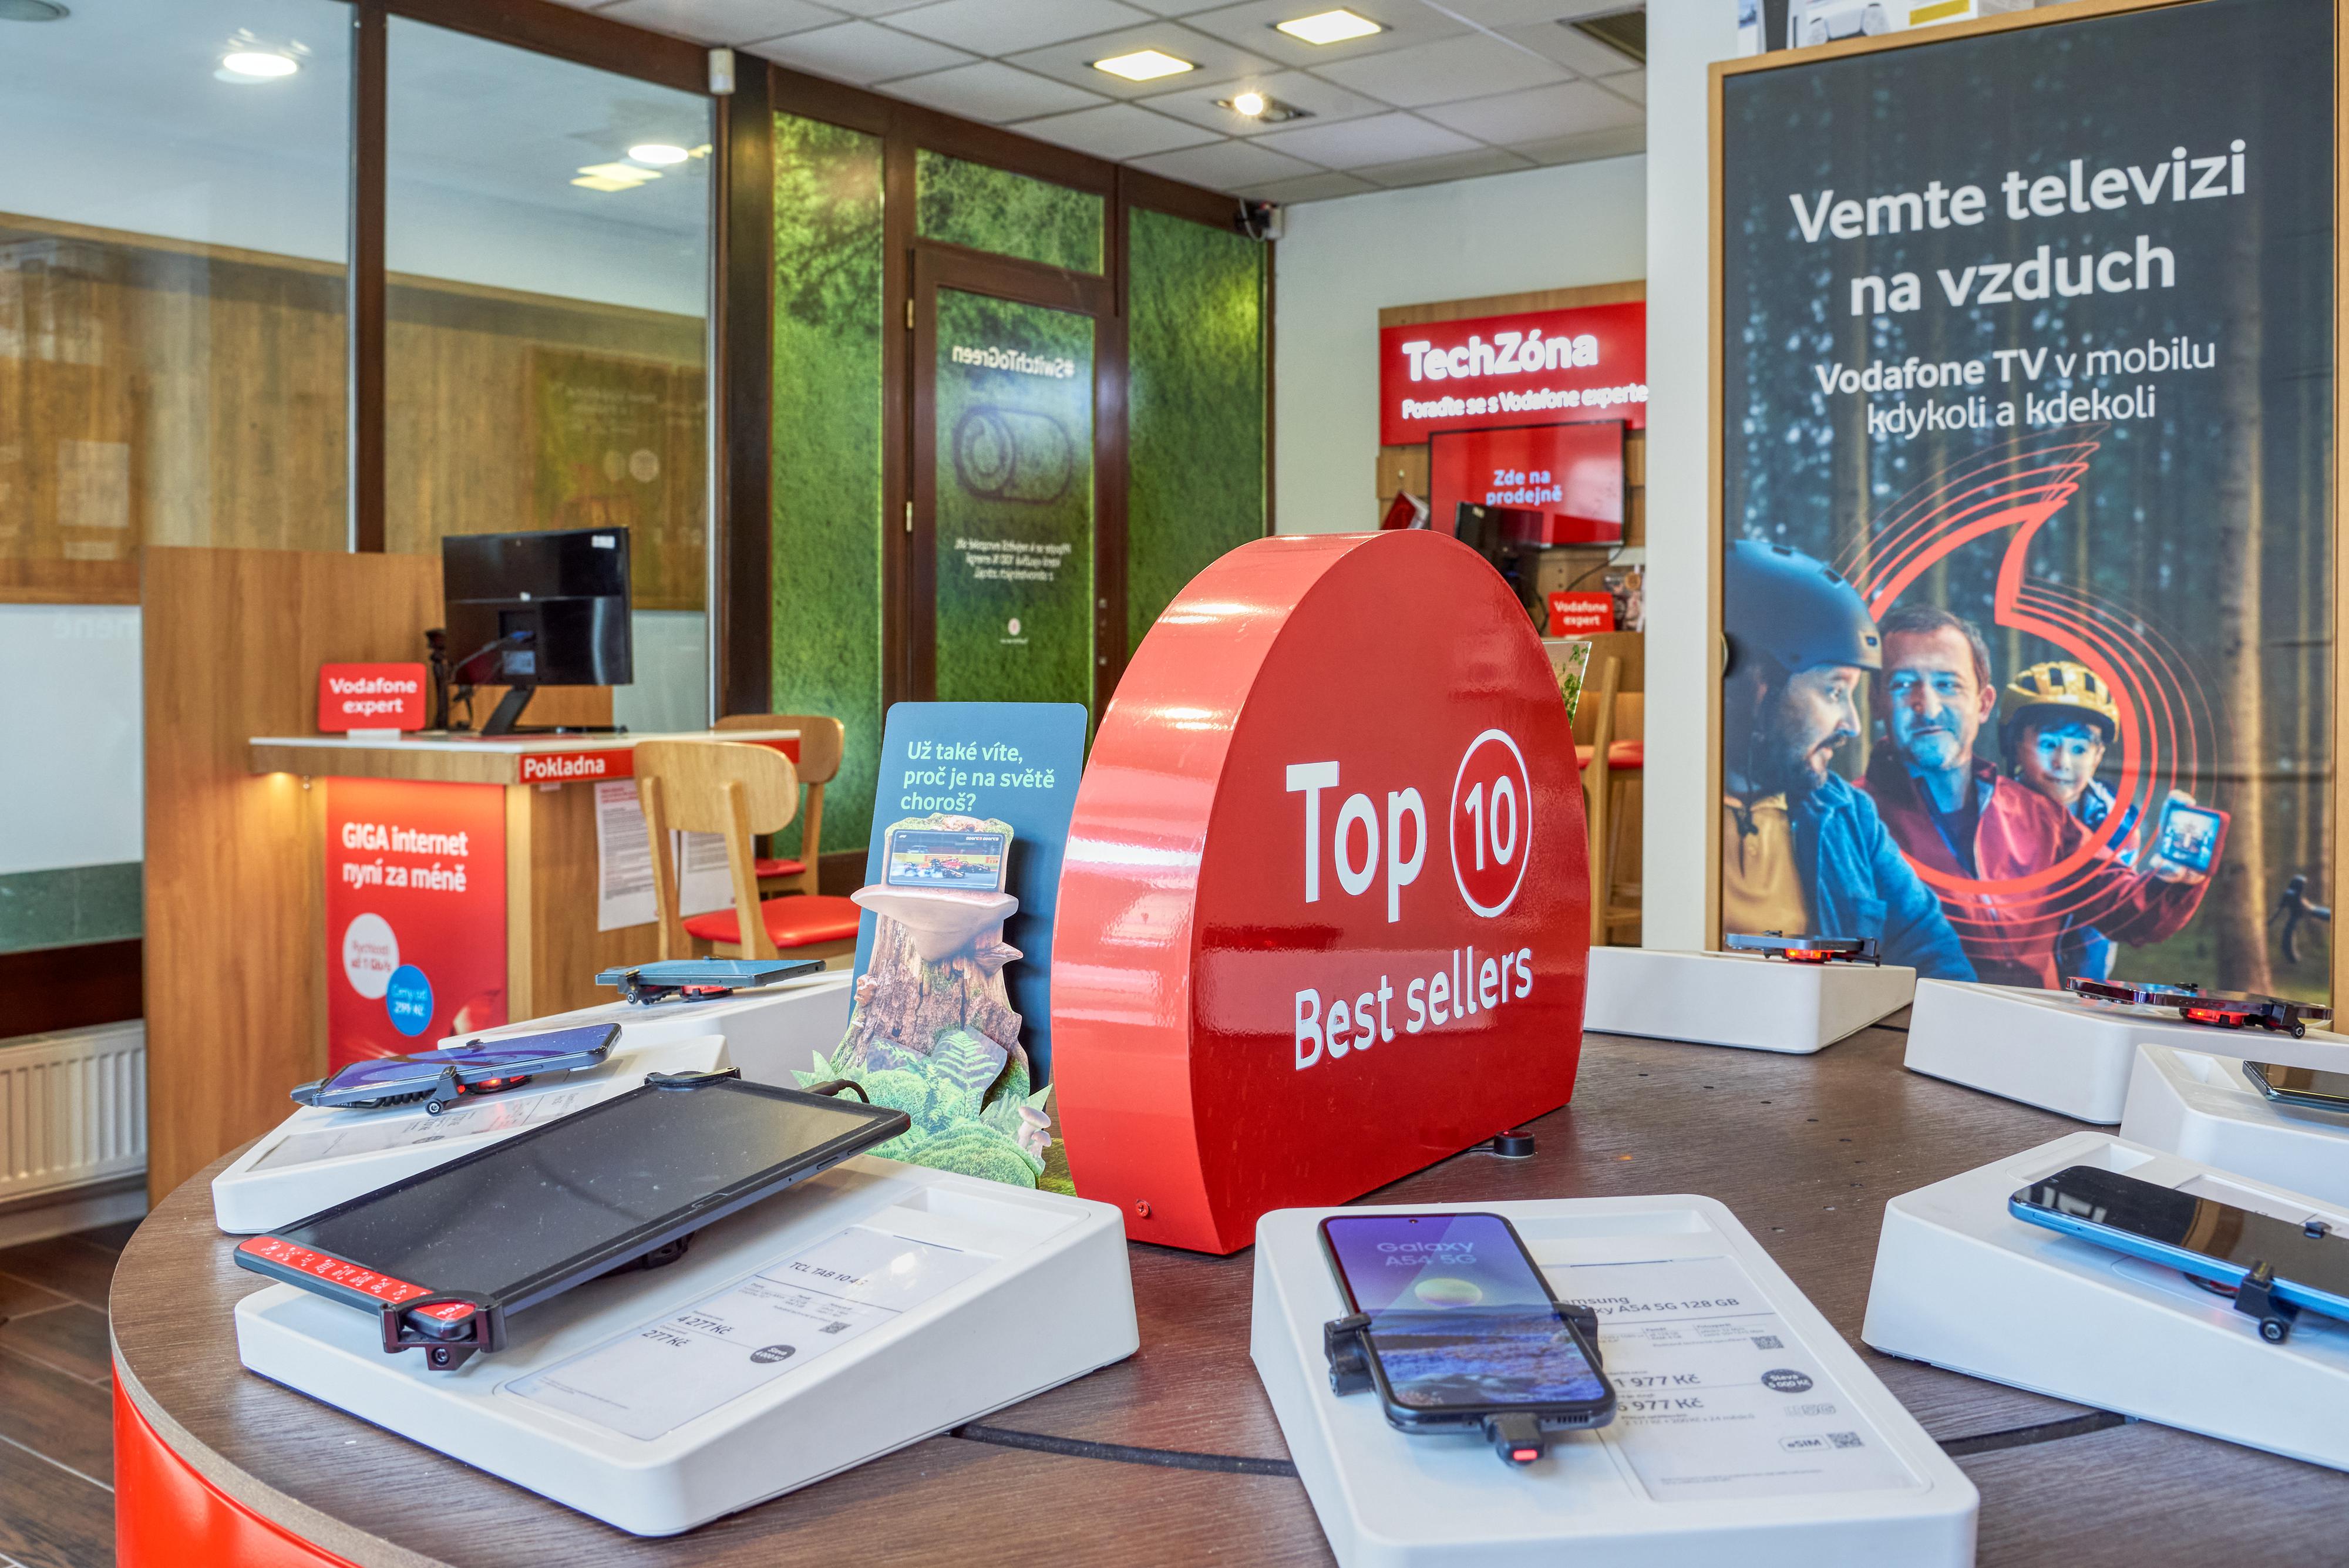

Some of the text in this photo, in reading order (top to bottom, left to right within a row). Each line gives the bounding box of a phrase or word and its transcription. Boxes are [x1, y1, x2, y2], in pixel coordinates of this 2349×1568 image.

[1789, 139, 2246, 243] Vemte televizi
[1851, 235, 2175, 316] na vzduch
[1402, 329, 1598, 382] TechZóna
[1815, 337, 2215, 395] Vodafone TV v mobilu
[1466, 398, 1486, 415] se
[1487, 396, 1499, 413] s
[1499, 388, 1580, 412] Vodafone
[1581, 383, 1648, 408] experte
[1867, 385, 2156, 440] kdykoli a kdekoli
[1494, 470, 1550, 486] Zde na
[1486, 485, 1562, 506] prodejně
[1554, 600, 1608, 614] Vodafone
[1563, 614, 1600, 628] expert
[329, 677, 417, 695] Vodafone
[342, 695, 403, 715] expert
[908, 741, 1024, 763] Už také víte,
[524, 755, 605, 779] Pokladna
[904, 766, 1055, 790] proč je na světě
[901, 792, 977, 812] choroš?
[342, 823, 469, 857] GIGA internet
[1286, 761, 1517, 923] Top 10
[343, 858, 467, 892] nyní za méně
[1295, 945, 1532, 1071] Best sellers
[1377, 1242, 1473, 1253] Galaxy
[1385, 1254, 1477, 1266] A54 5G
[789, 1261, 809, 1273] TCL
[811, 1268, 836, 1278] TAB
[834, 1273, 851, 1282] 10
[1619, 1303, 1651, 1313] A54
[1656, 1301, 1678, 1311] 5G
[1681, 1300, 1712, 1309] 128
[1715, 1298, 1739, 1307] GB
[685, 1318, 715, 1330] 277
[714, 1324, 735, 1335] Kč
[642, 1330, 672, 1342] 277
[667, 1337, 691, 1347] Kč
[1614, 1374, 1701, 1387] 1 977 Kč
[1617, 1397, 1704, 1411] 6 977 Kč
[1787, 1439, 1822, 1448] eSIM
